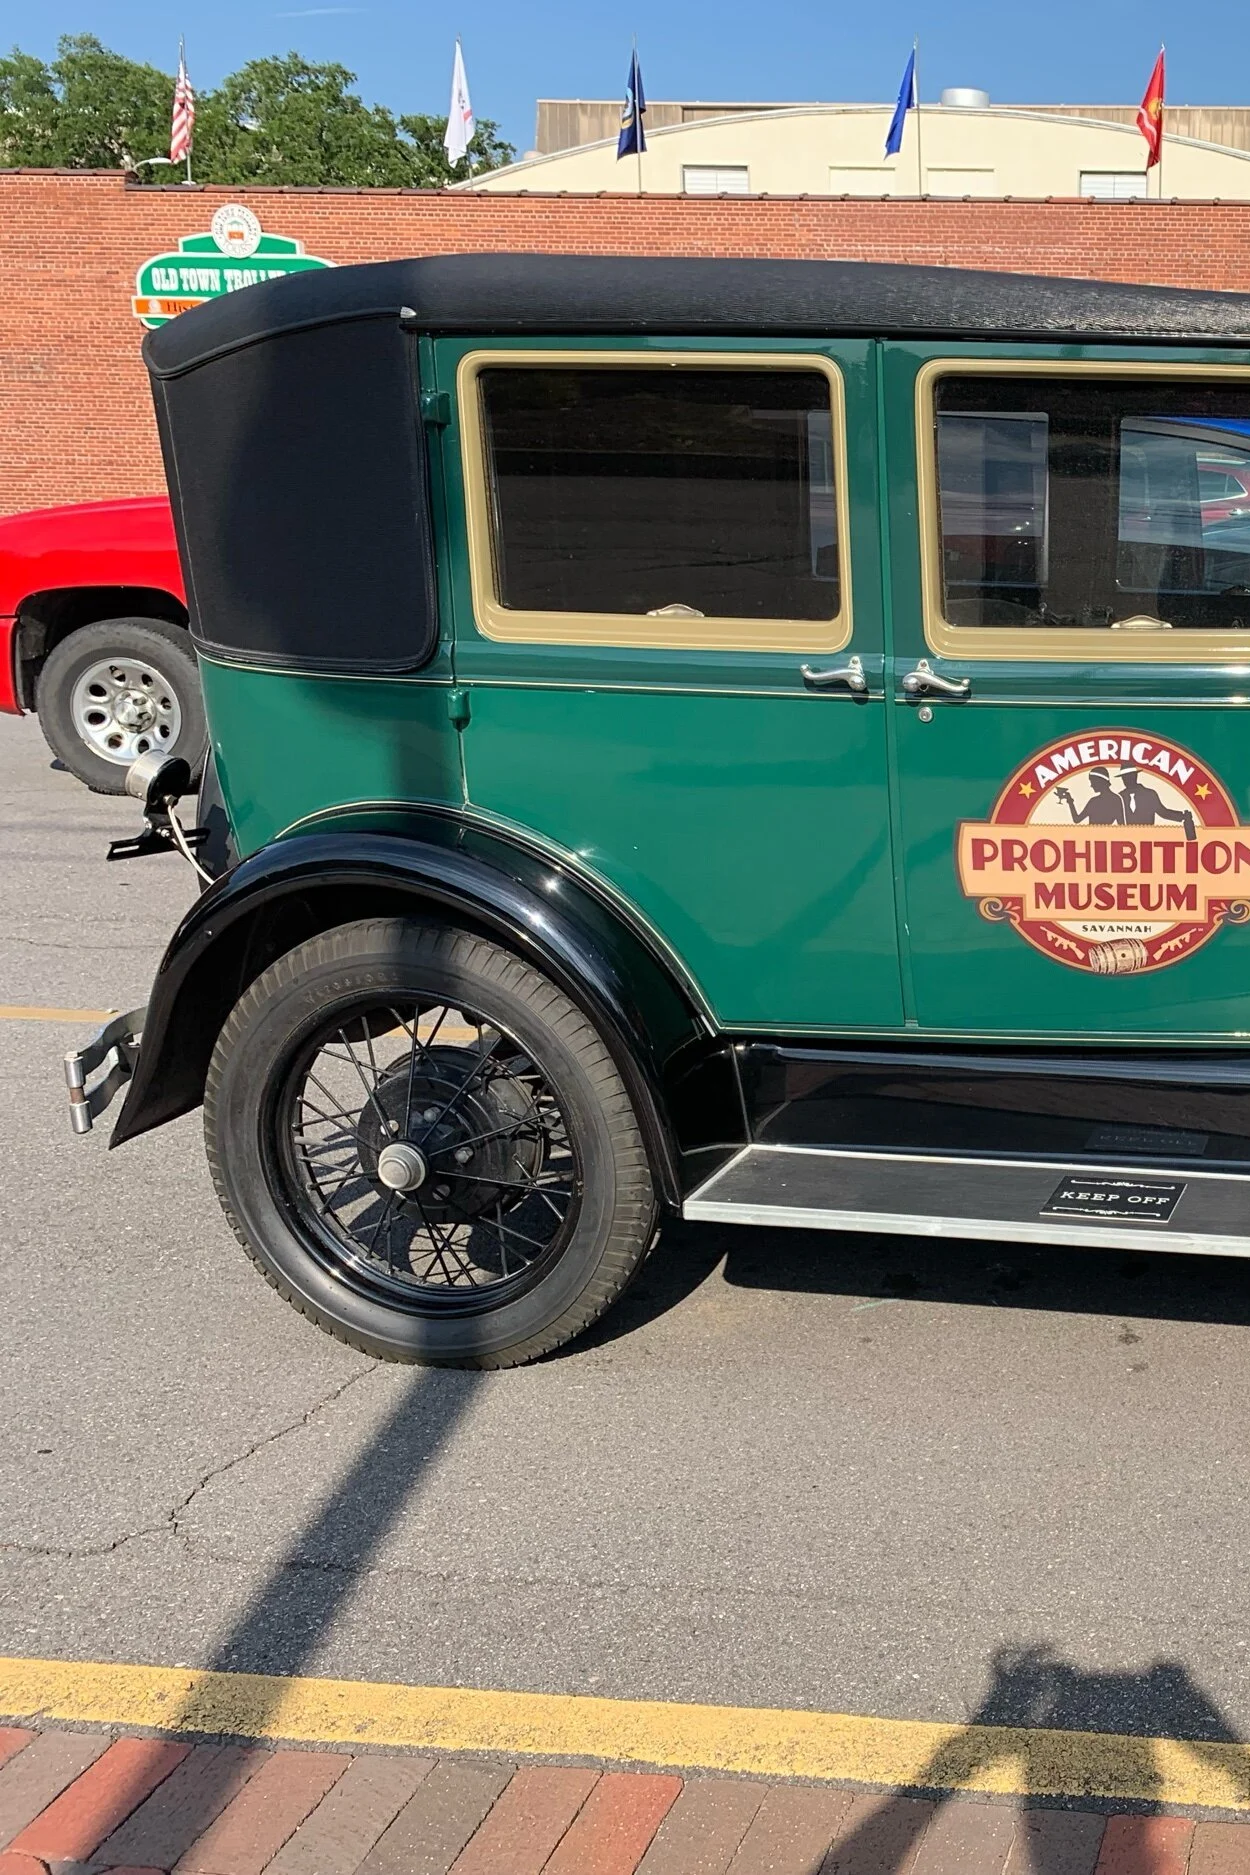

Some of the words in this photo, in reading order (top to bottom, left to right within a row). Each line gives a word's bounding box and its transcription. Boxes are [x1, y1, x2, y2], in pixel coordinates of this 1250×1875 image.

[151, 267, 179, 291] OLD
[179, 267, 220, 292] TOWN
[1034, 739, 1195, 788] AMERICAN
[1034, 882, 1198, 912] MUSEUM
[1082, 924, 1152, 934] SAVANNAH
[1060, 1191, 1120, 1202] KEEP
[1127, 1195, 1170, 1205] OFF
